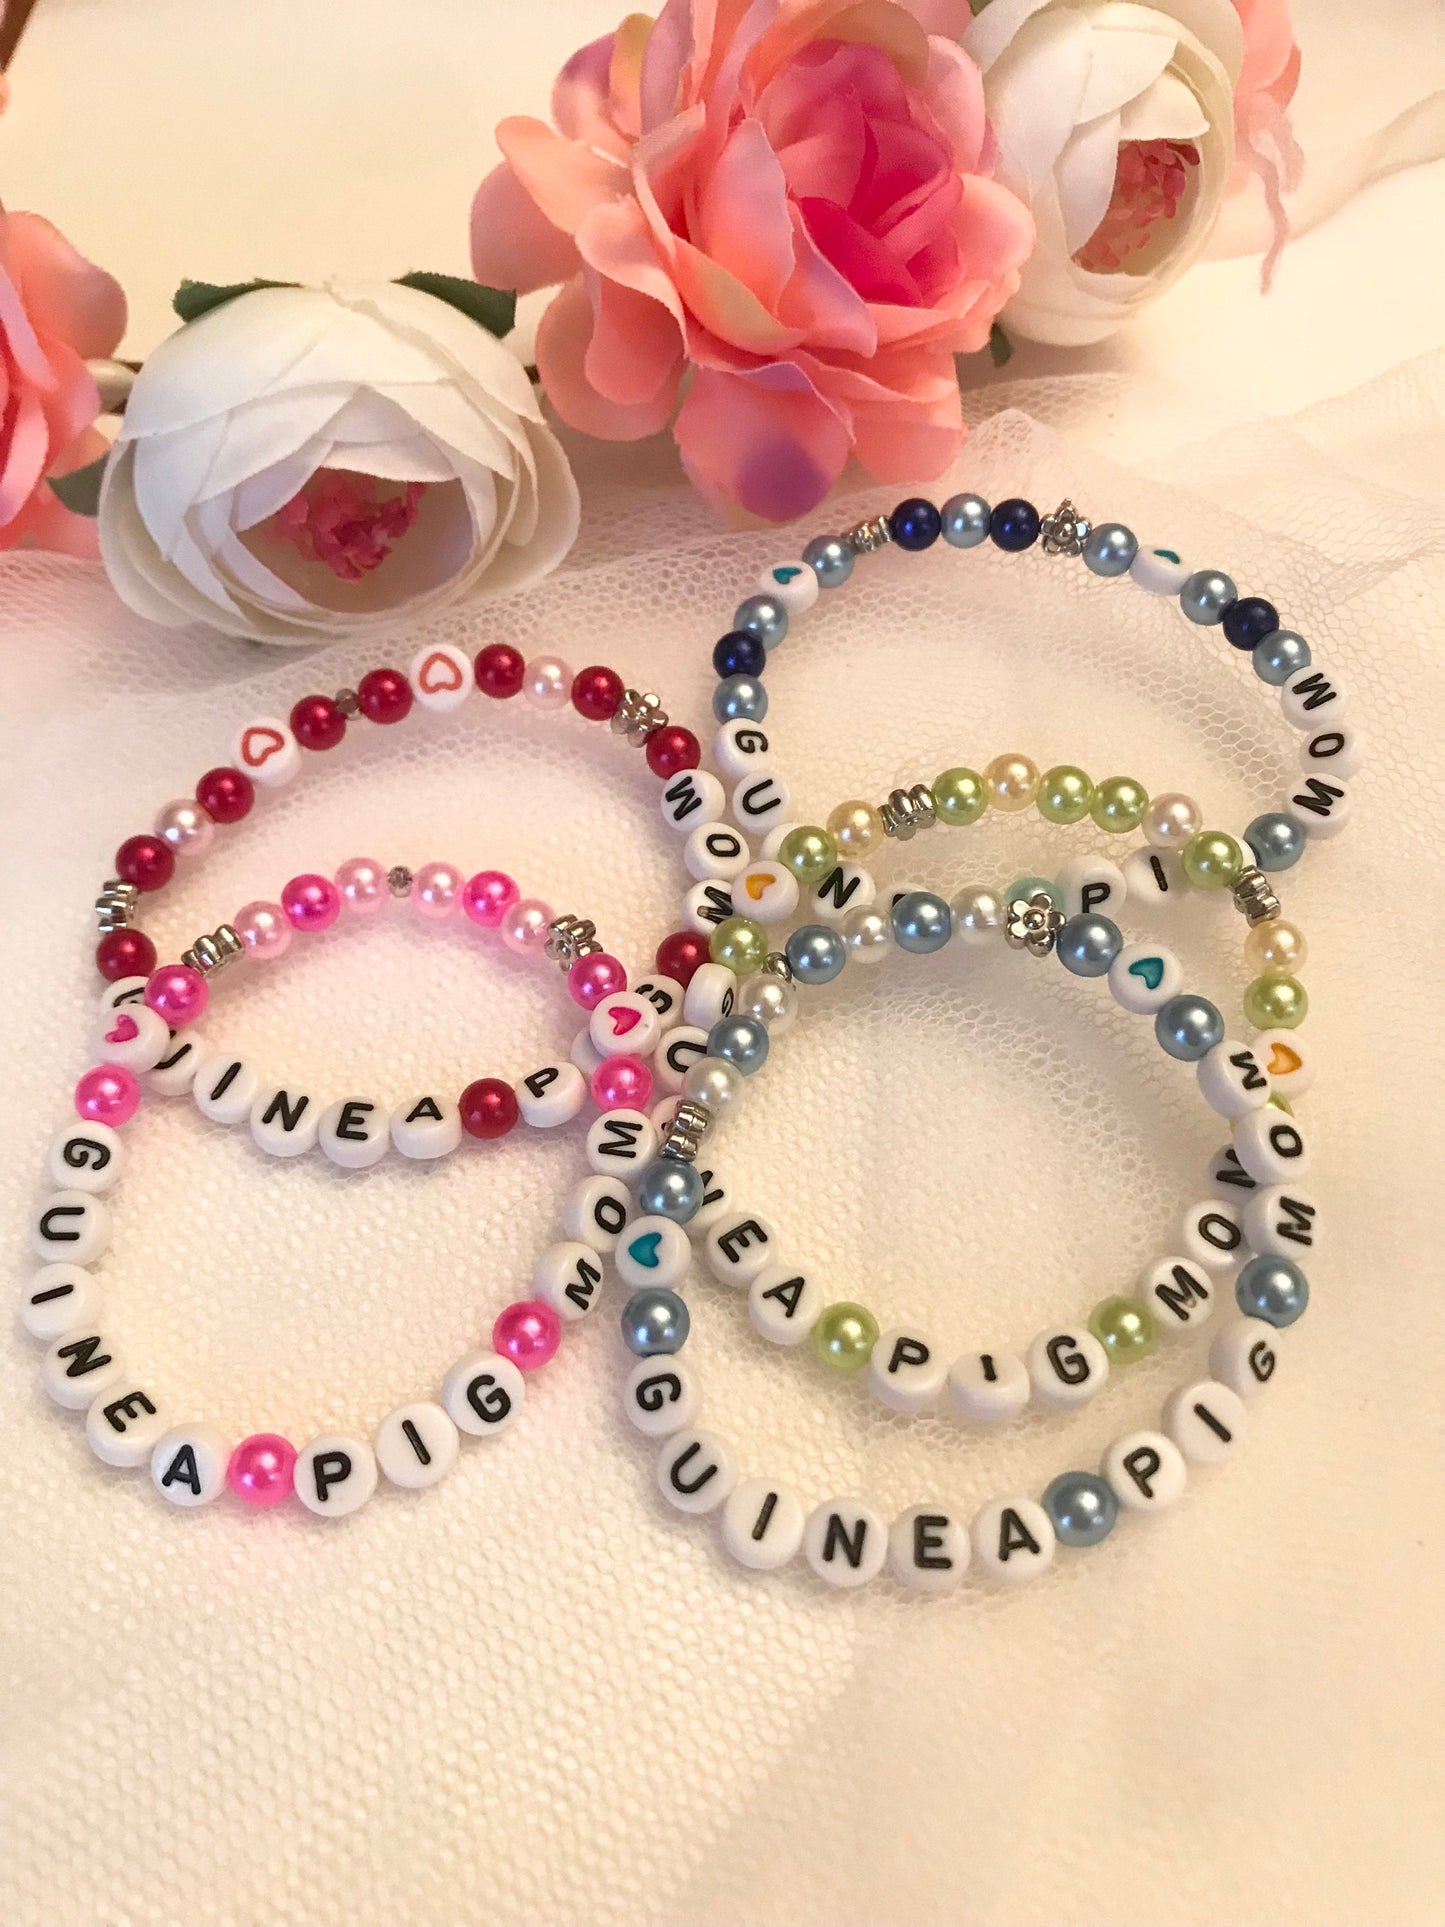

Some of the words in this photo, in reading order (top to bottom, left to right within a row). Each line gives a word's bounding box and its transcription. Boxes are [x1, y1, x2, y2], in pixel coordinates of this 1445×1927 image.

[1293, 673, 1345, 816] MOM
[525, 983, 673, 1099] PG
[31, 1137, 202, 1496] GUINEA
[312, 1374, 512, 1502] PIG
[564, 1120, 643, 1311] MOM
[635, 1373, 1040, 1570] GUINEA
[1123, 1342, 1275, 1498] PIG
[1230, 1051, 1316, 1247] MOM
[889, 1336, 1090, 1385] PIG
